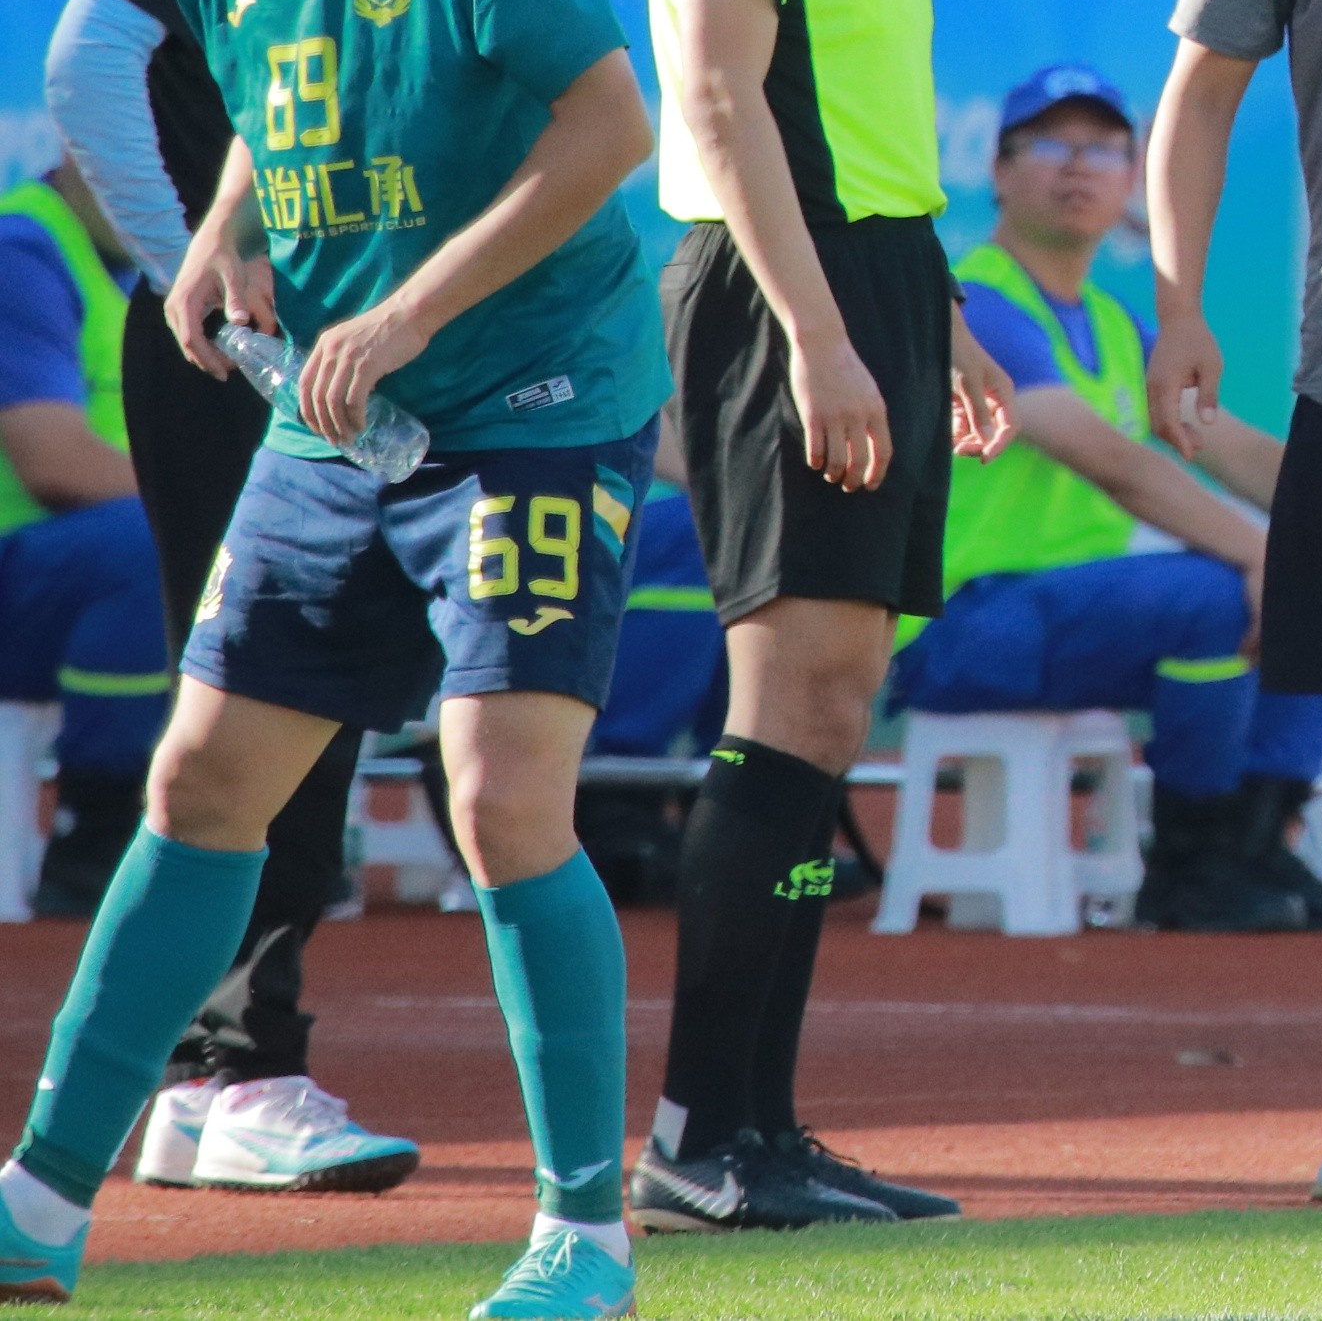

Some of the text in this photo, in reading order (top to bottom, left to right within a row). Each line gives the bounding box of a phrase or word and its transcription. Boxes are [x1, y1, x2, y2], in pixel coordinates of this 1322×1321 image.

[266, 36, 340, 150] 69
[386, 216, 426, 231] CLUB
[468, 495, 581, 601] 69
